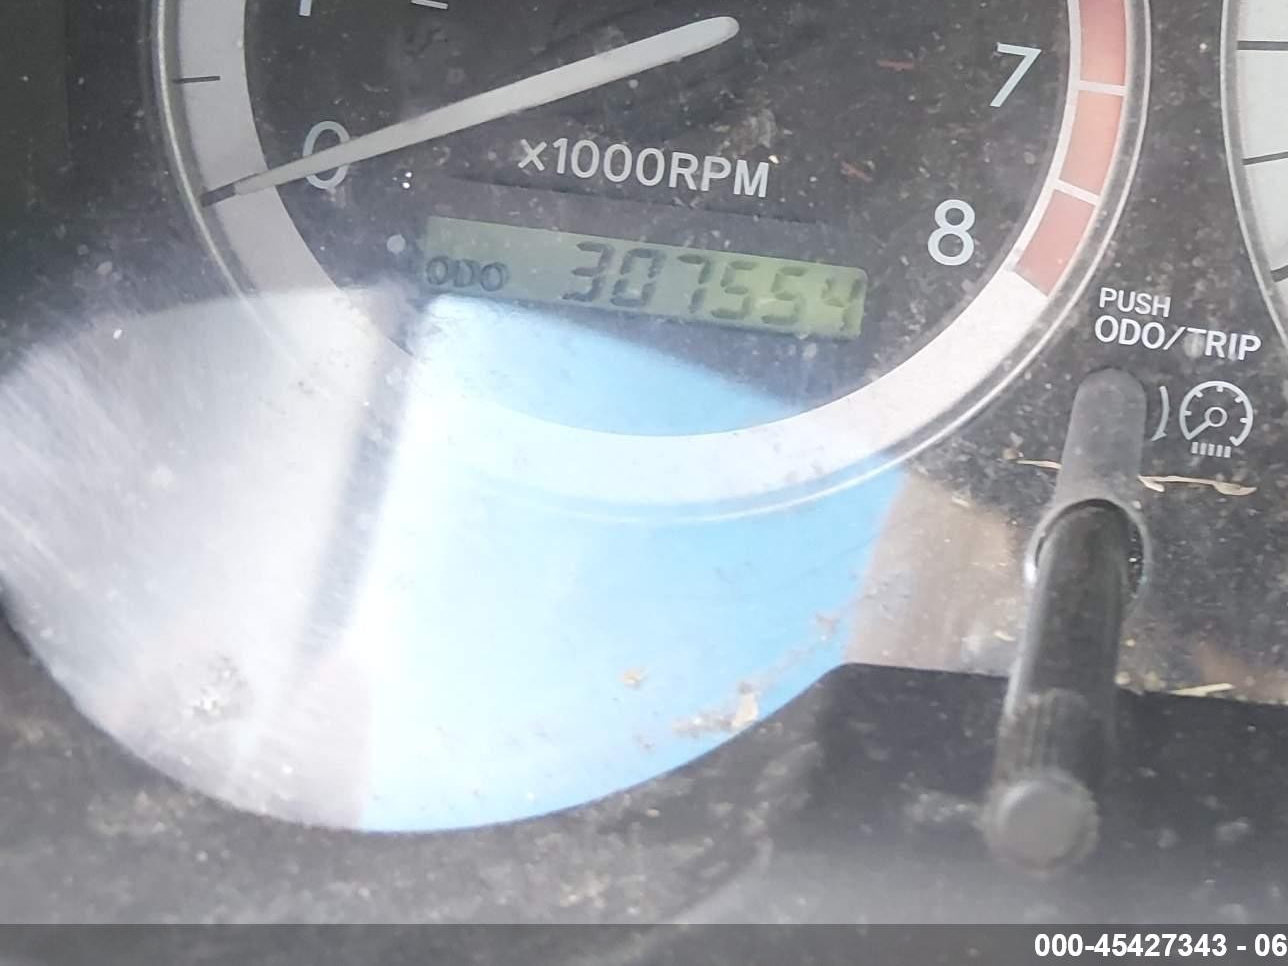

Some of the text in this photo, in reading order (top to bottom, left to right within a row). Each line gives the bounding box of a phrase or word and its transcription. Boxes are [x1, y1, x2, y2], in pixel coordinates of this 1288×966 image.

[989, 41, 1043, 108] 7
[302, 120, 350, 190] 0
[927, 199, 976, 266] 8
[425, 240, 866, 332] ODO 307554
[1099, 286, 1171, 318] PUSH
[1094, 314, 1262, 362] ODO/TRIP
